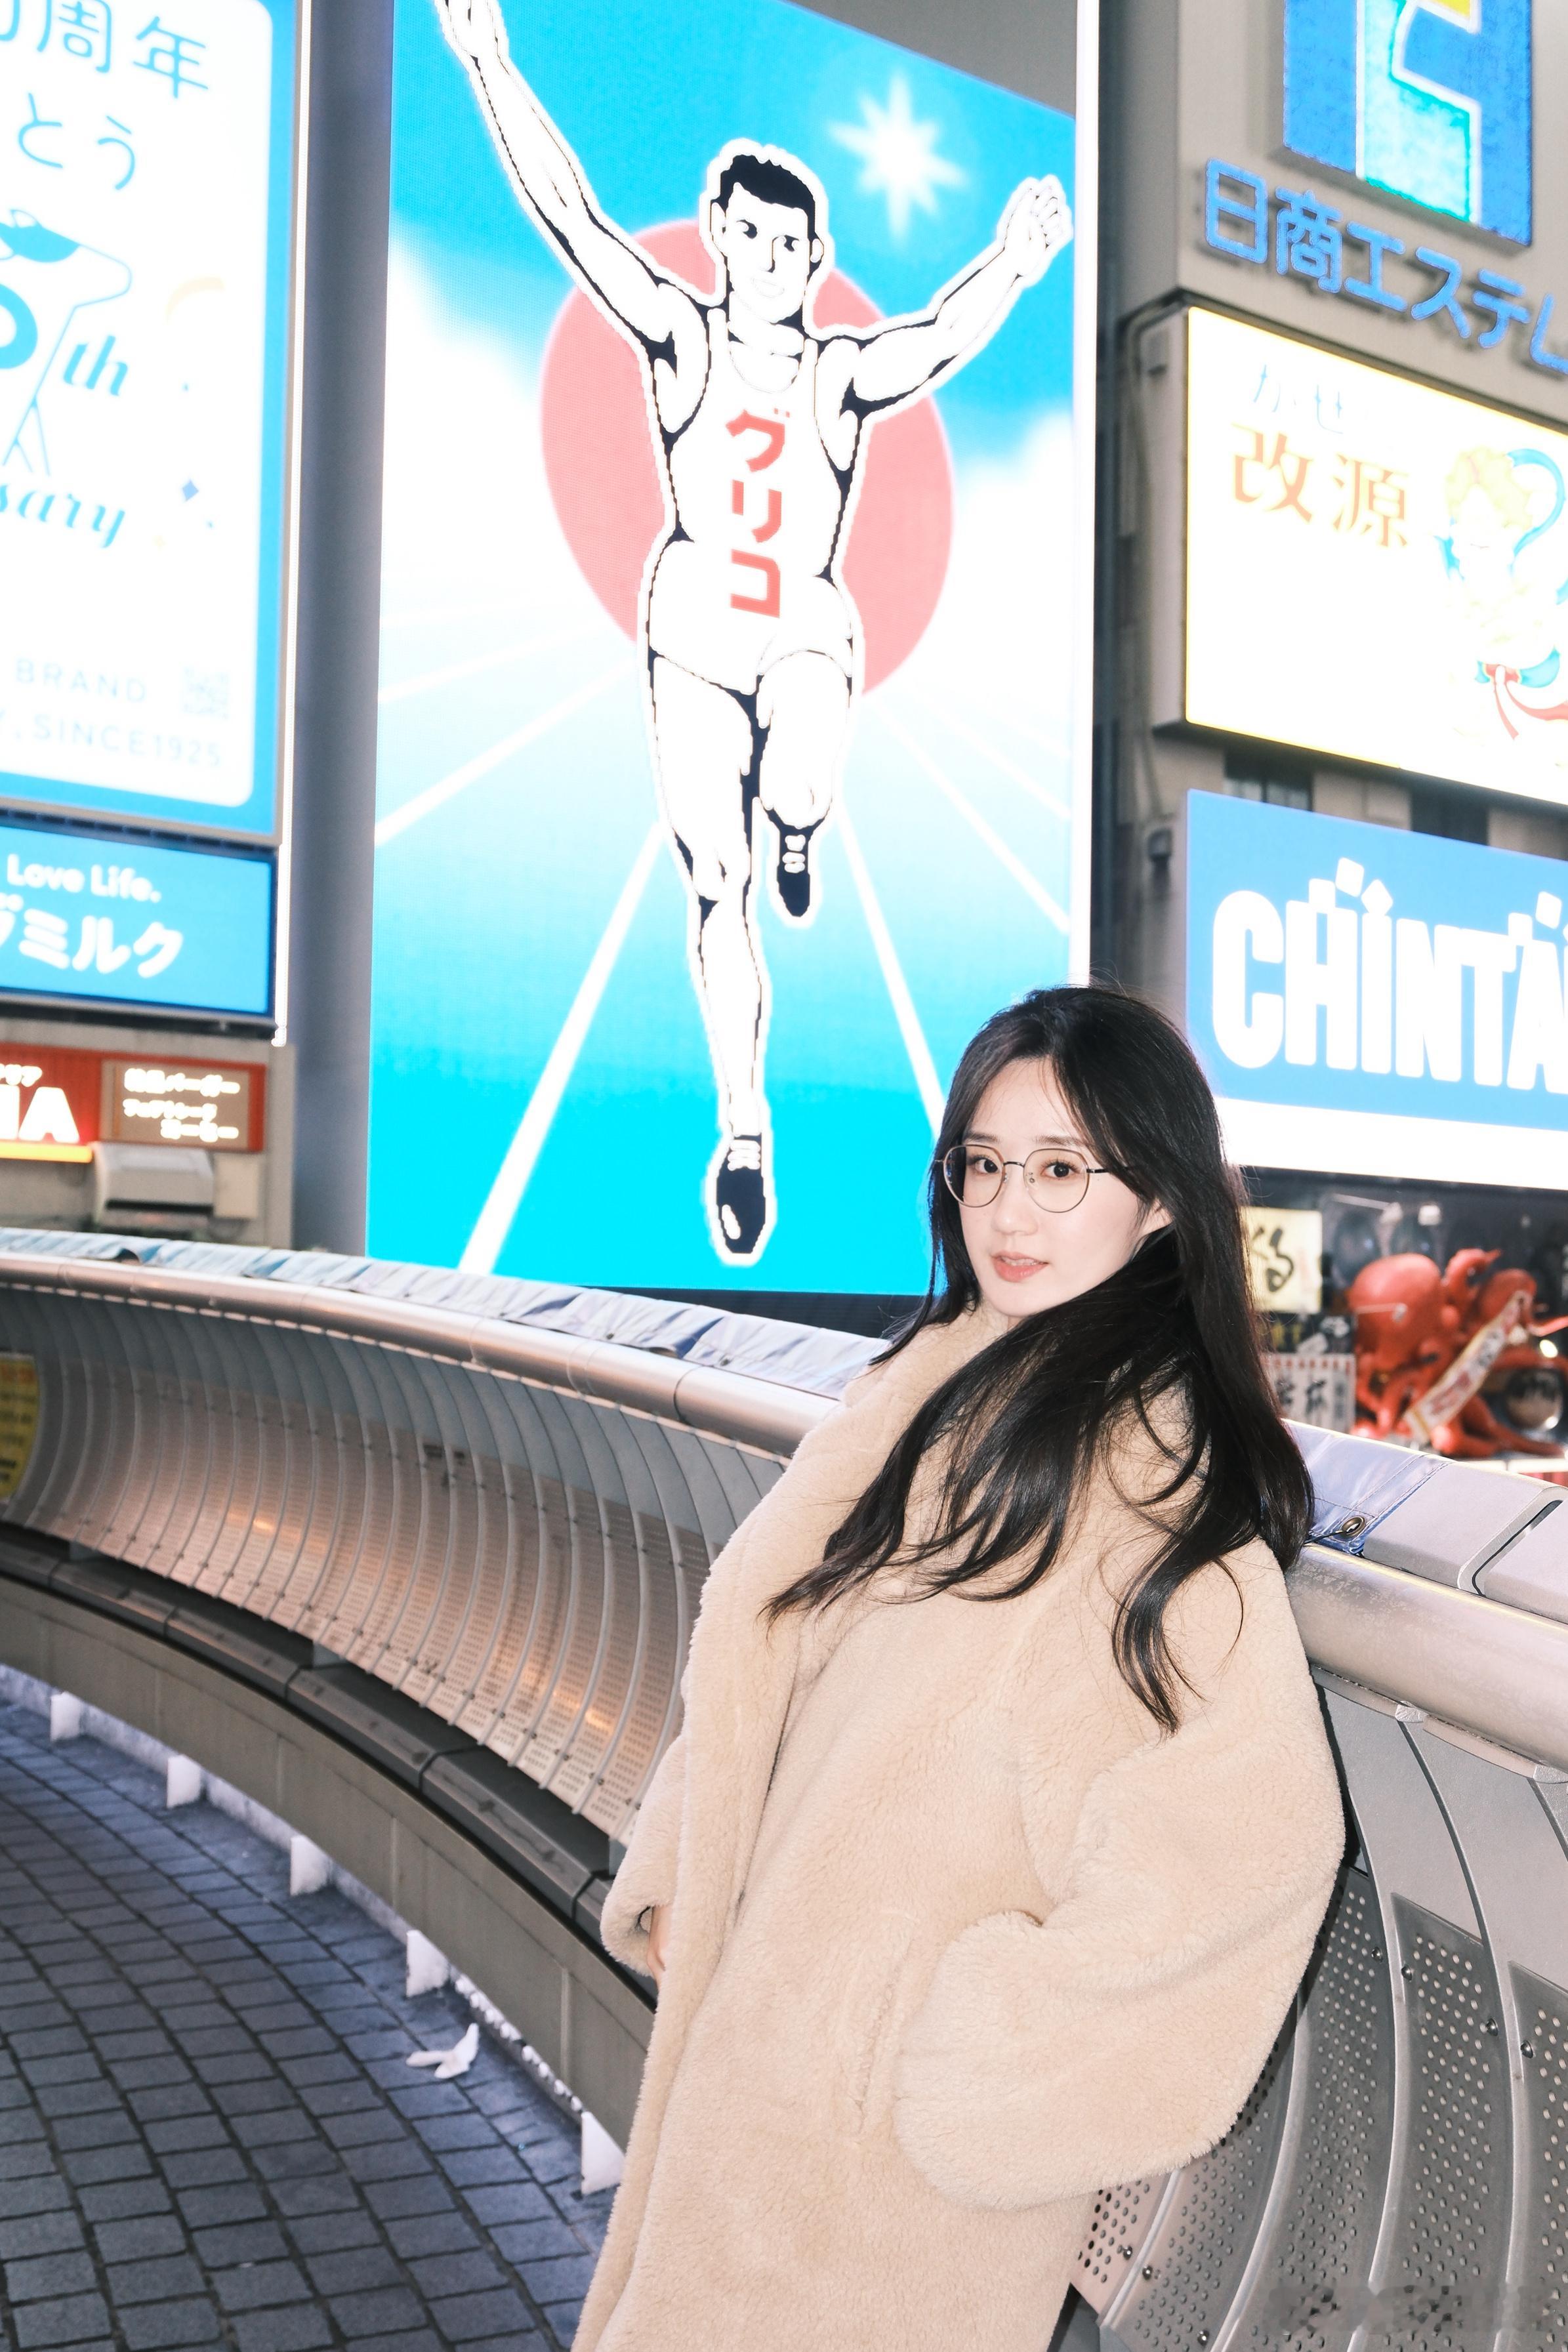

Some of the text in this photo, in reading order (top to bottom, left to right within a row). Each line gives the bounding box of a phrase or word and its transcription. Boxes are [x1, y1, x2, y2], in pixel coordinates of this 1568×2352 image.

[0, 0, 209, 98] 周年
[18, 92, 136, 190] とう
[726, 408, 790, 618] グリコ
[1231, 423, 1409, 548] 改源
[15, 657, 148, 703] BRAND
[7, 854, 162, 903] Love Life.
[1212, 857, 1568, 1096] CHINTA
